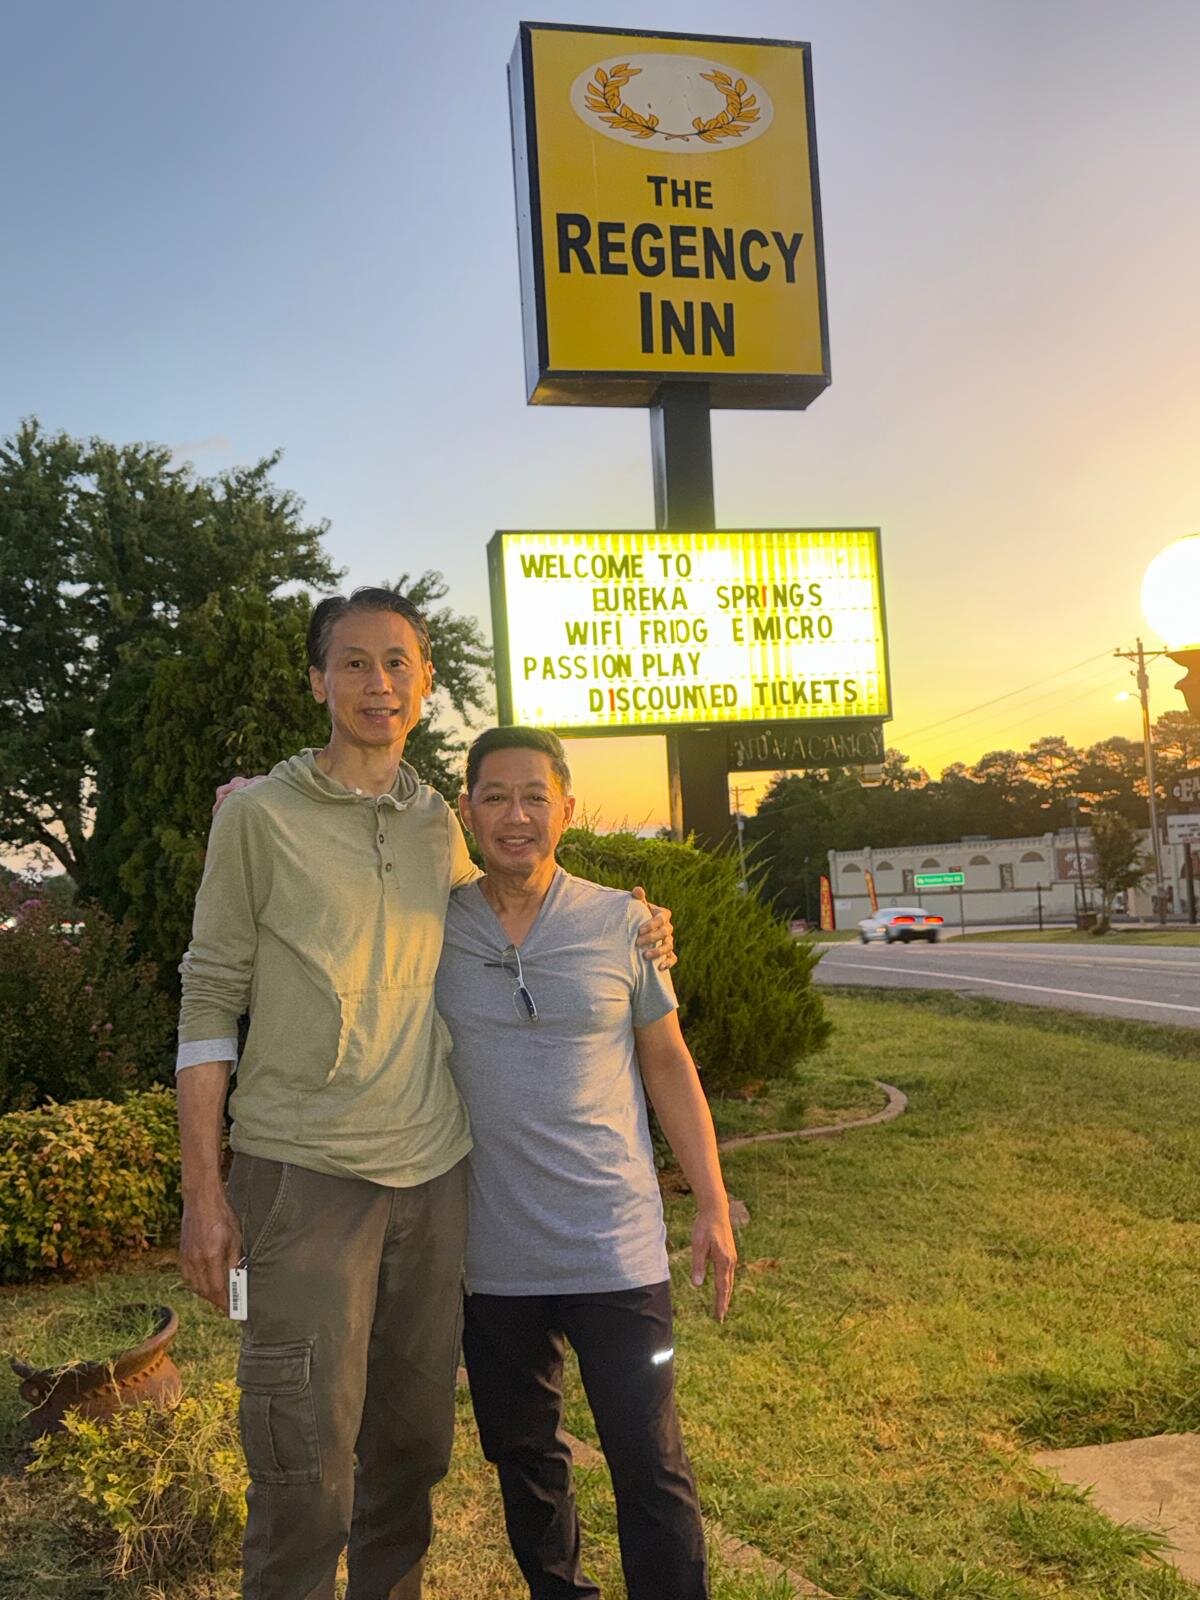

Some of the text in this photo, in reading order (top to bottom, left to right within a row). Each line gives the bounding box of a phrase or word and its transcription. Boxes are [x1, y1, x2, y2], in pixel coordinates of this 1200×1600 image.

[646, 175, 713, 209] THE
[555, 212, 804, 284] REGENCY
[639, 291, 736, 357] INN
[520, 553, 692, 579] WELCOME TO
[592, 583, 823, 612] EUREKA SPRINGS
[565, 620, 622, 646] WIFI
[753, 615, 833, 641] MICRO
[523, 652, 701, 680] PASSION PLAY
[588, 679, 858, 712] DISCOUNTED TICKETS
[734, 732, 882, 762] NO VACANCY
